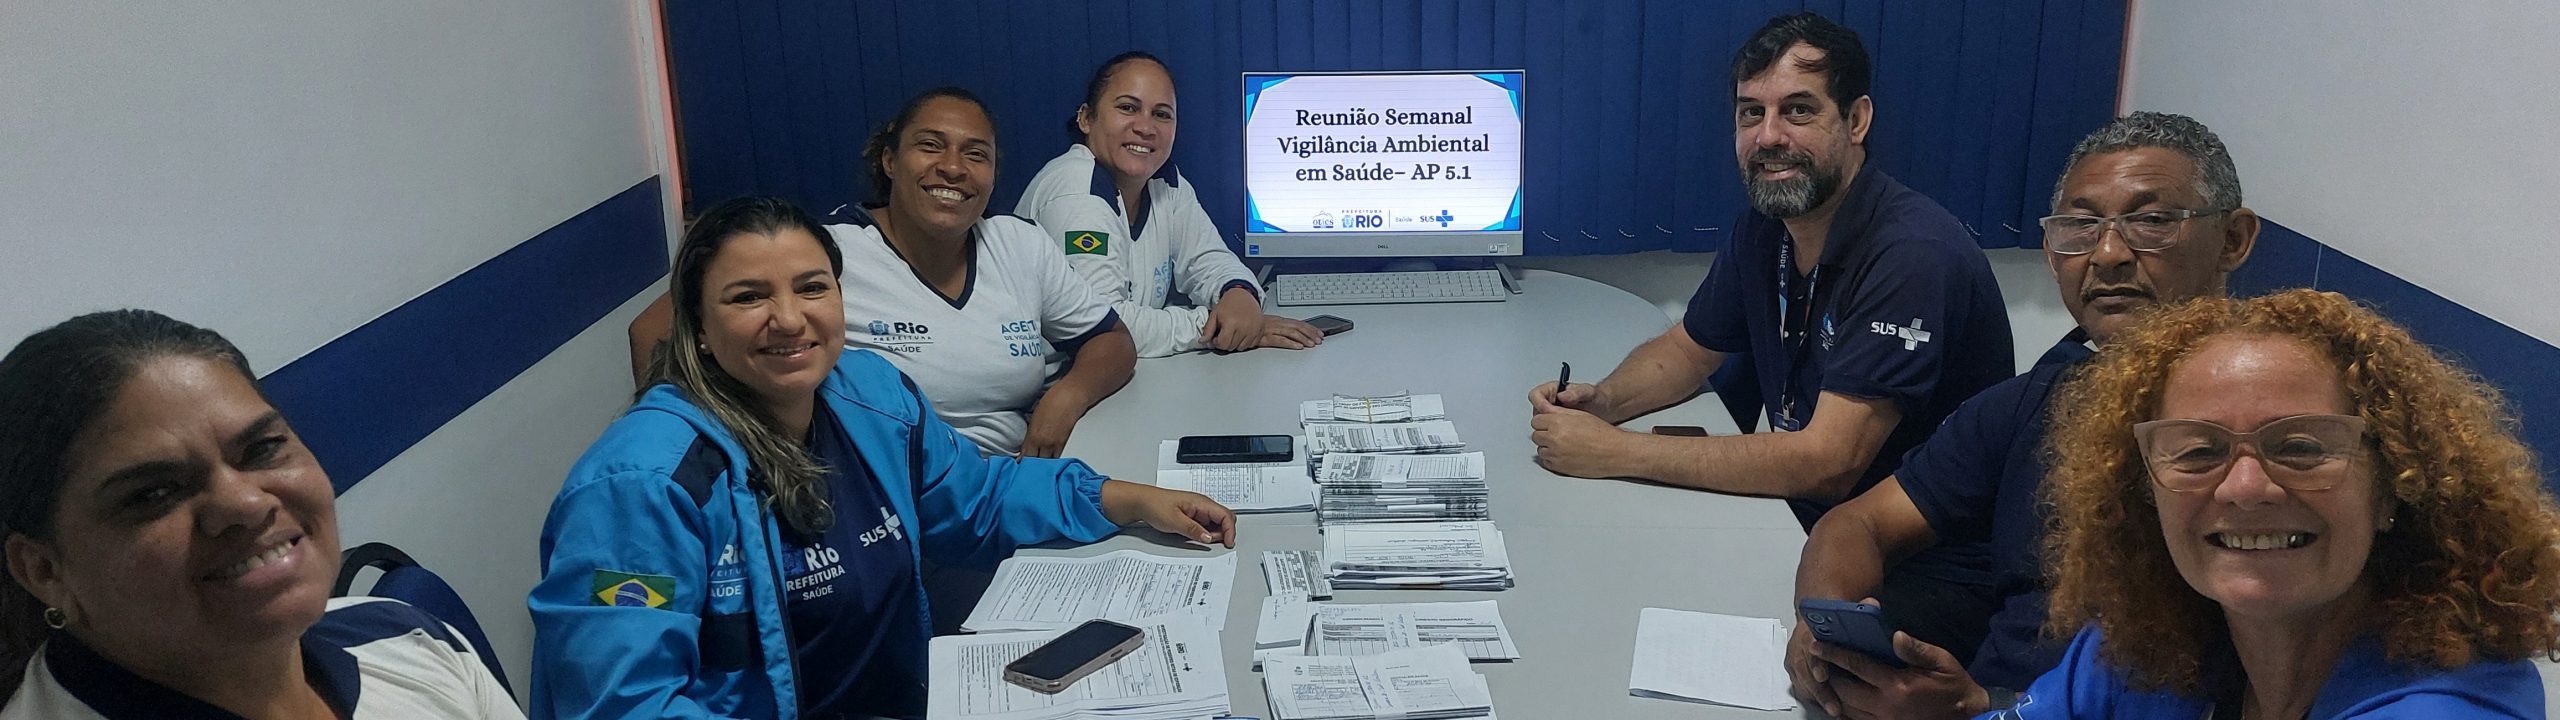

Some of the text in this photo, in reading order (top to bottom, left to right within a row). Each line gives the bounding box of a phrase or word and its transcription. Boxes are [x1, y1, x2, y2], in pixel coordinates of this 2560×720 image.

[1295, 106, 1472, 126] Reunião Semanal
[1277, 133, 1490, 158] Vigilância Ambiental
[1295, 167, 1327, 181] em
[1410, 163, 1441, 180] AP
[1445, 165, 1472, 180] 5.1
[1355, 214, 1383, 228] RIO
[1780, 245, 1789, 269] SAÚDE
[893, 322, 929, 334] Rio
[1870, 321, 1898, 335] SUS
[887, 345, 922, 353] SAÚDE
[859, 524, 888, 547] SUS
[804, 542, 840, 572] Rio
[784, 564, 846, 592] REFEITURA
[802, 584, 834, 601] SAÚDE
